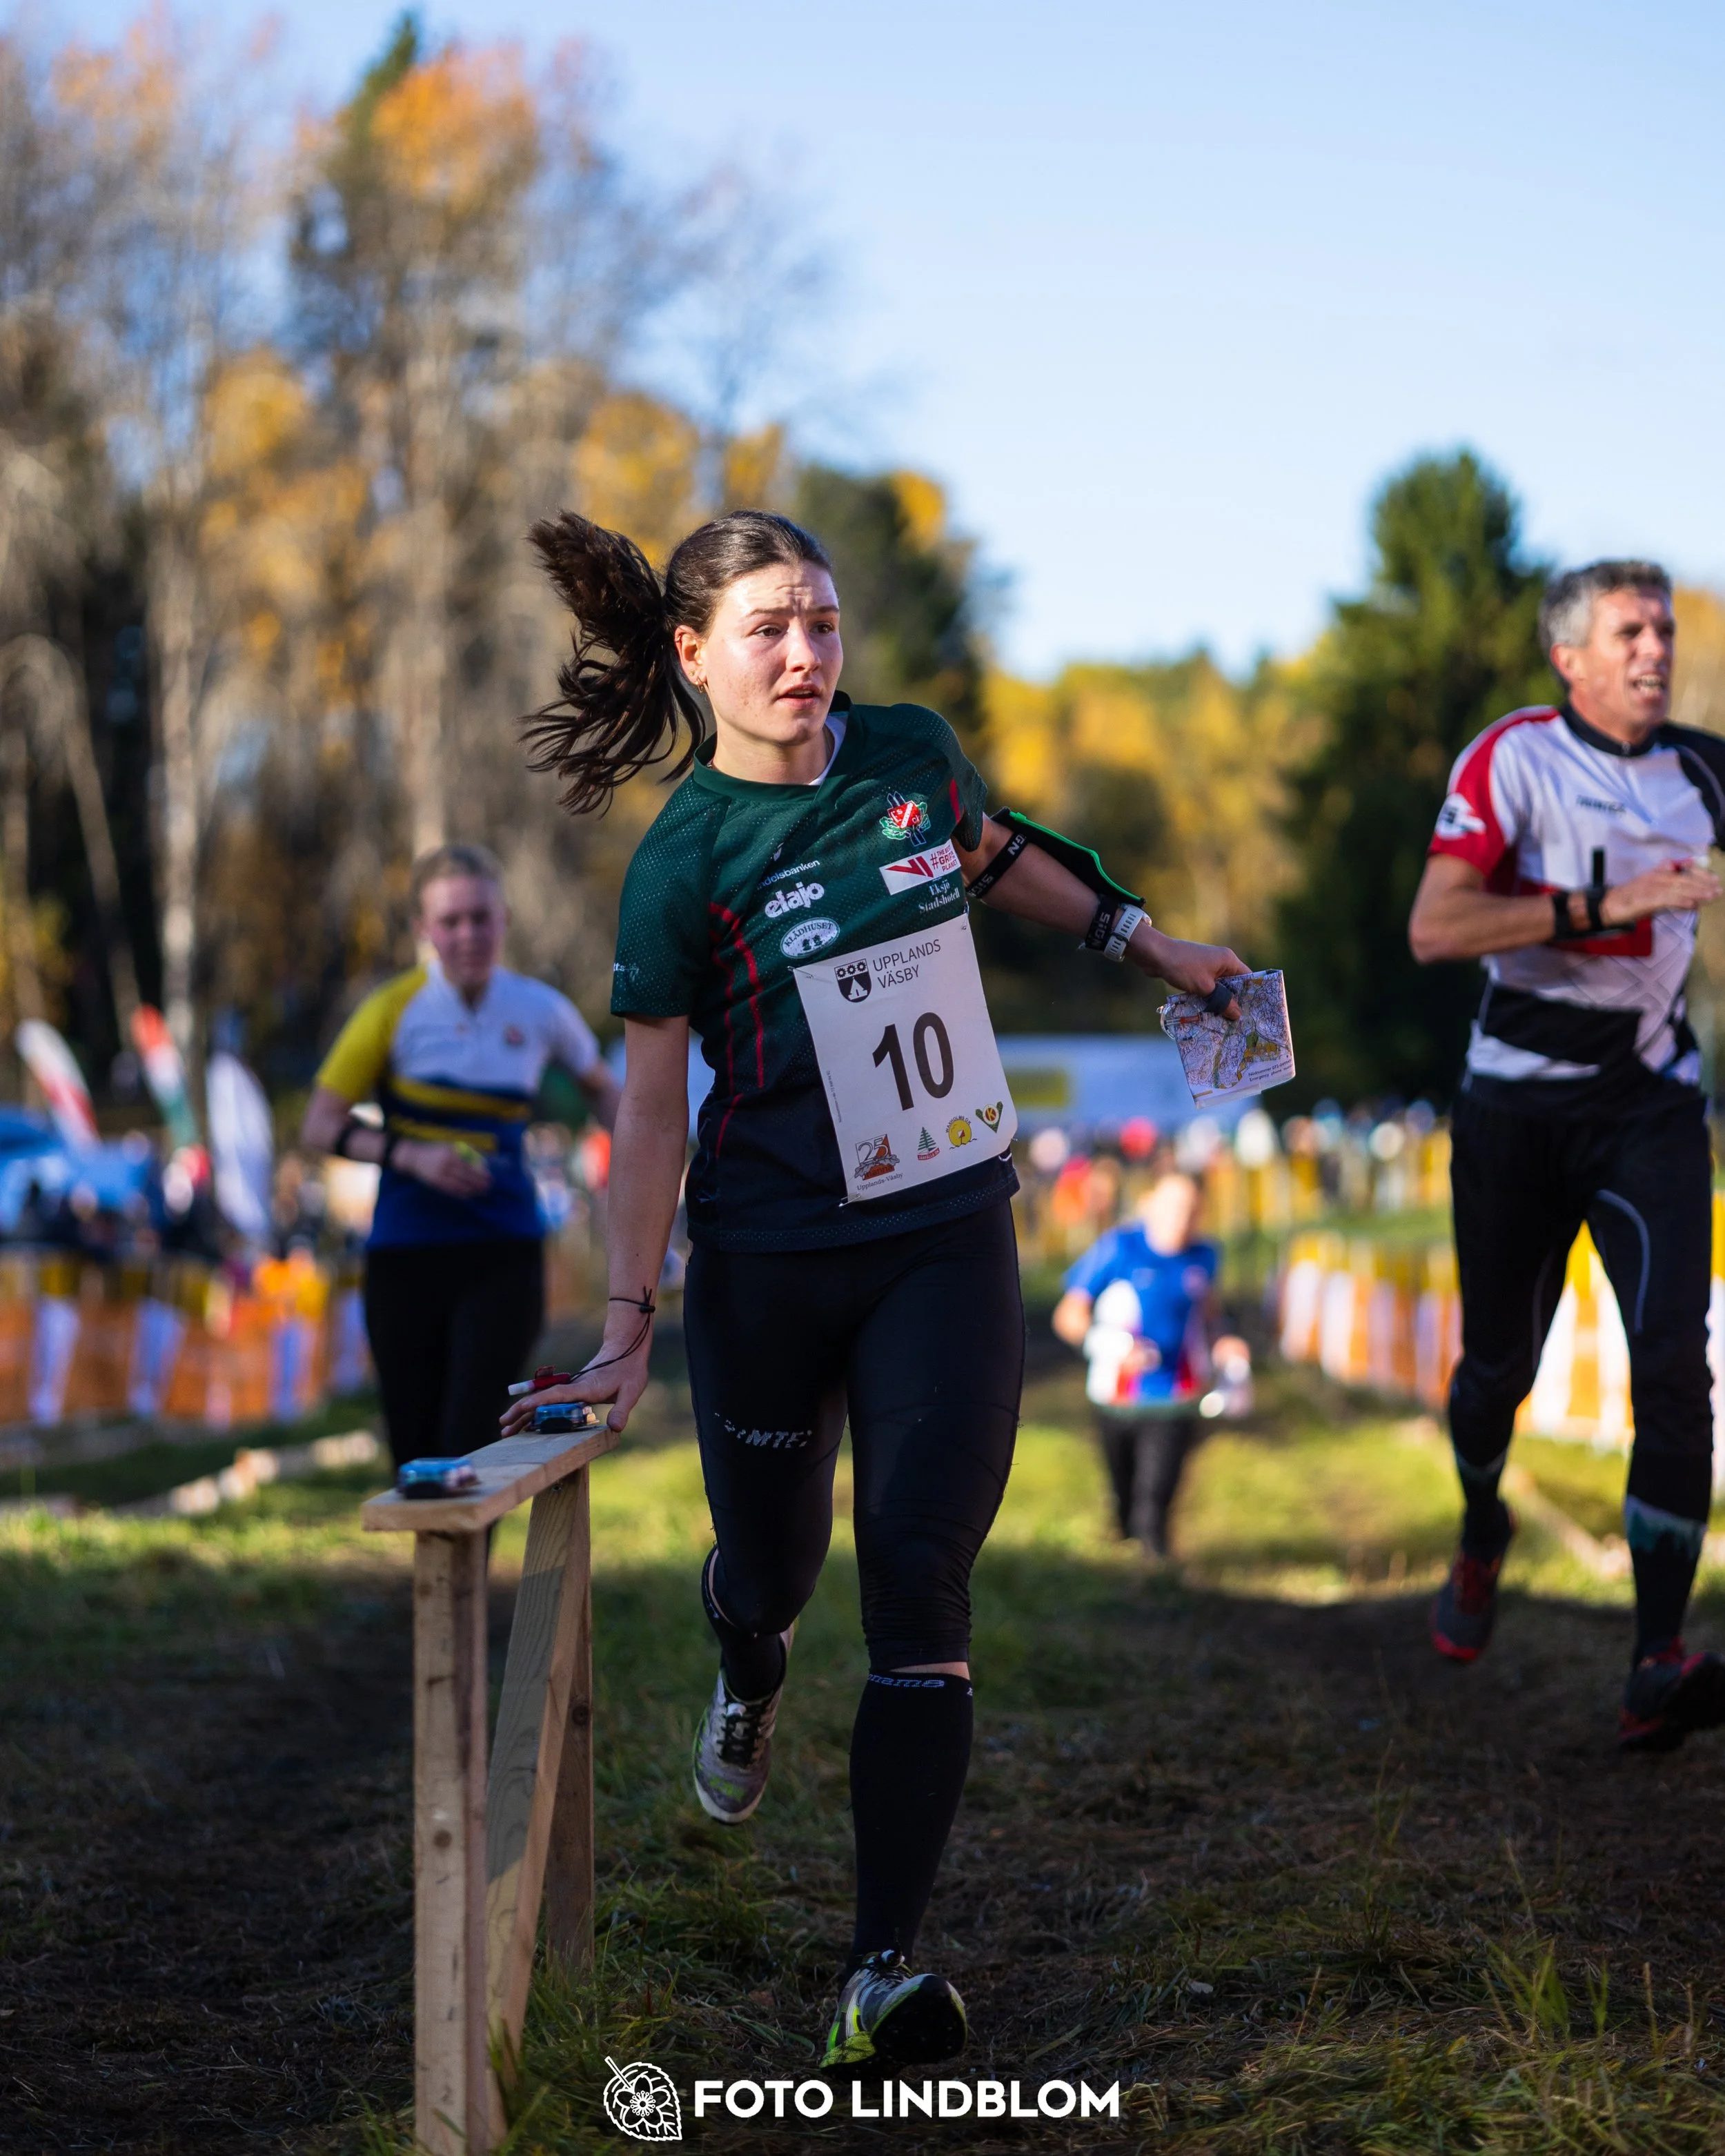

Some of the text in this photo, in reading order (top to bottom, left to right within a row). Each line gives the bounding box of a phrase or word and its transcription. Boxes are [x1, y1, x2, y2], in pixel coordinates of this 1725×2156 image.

[918, 887, 960, 912] Stadshotell
[873, 939, 941, 972] UPPLANDS
[877, 964, 919, 989] VÄSBY
[872, 1011, 954, 1111] 10
